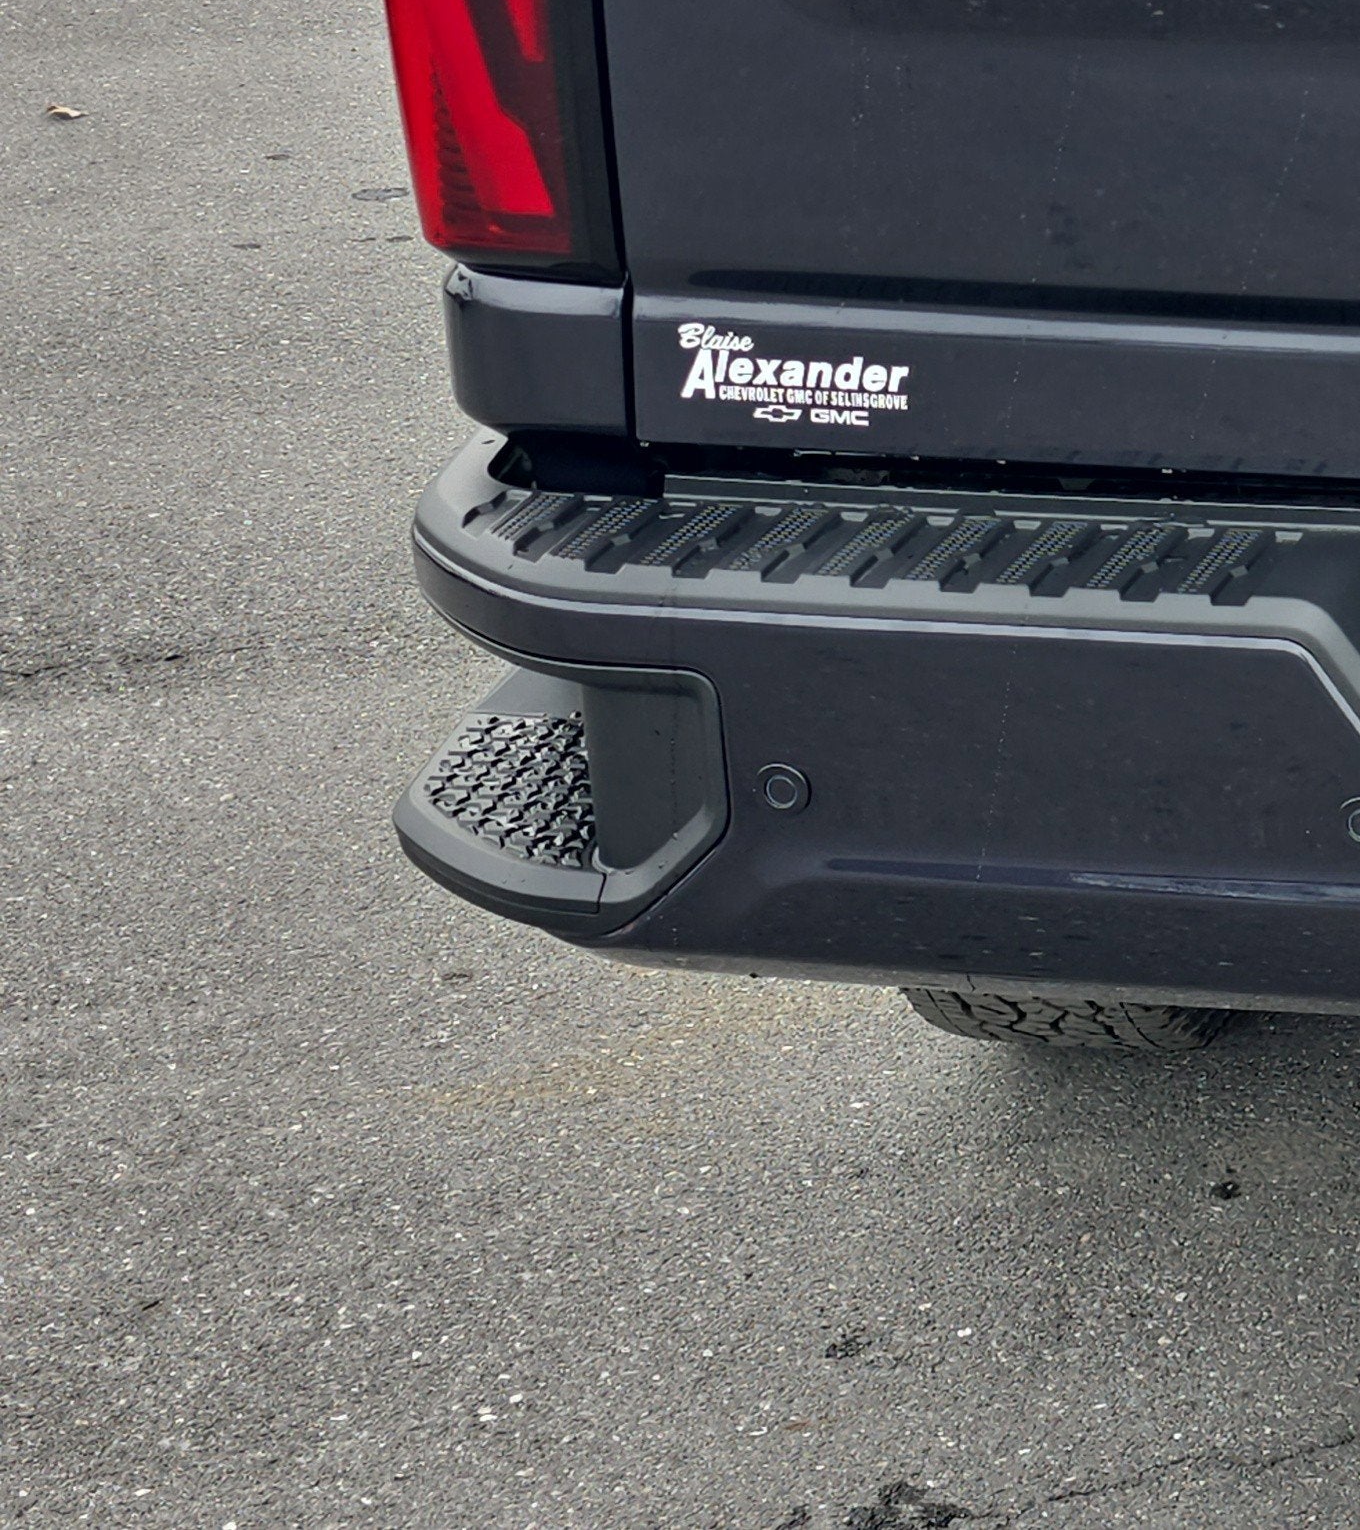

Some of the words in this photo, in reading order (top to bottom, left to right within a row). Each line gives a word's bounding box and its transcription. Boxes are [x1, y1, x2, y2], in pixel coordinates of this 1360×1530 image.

[678, 322, 754, 351] Blaise
[680, 349, 909, 399] Alexander
[719, 385, 785, 403] CHEVROLET
[786, 388, 813, 405] GMC
[814, 390, 829, 406] OF
[830, 391, 909, 411] SELINSGROVE
[810, 408, 869, 426] GMC
